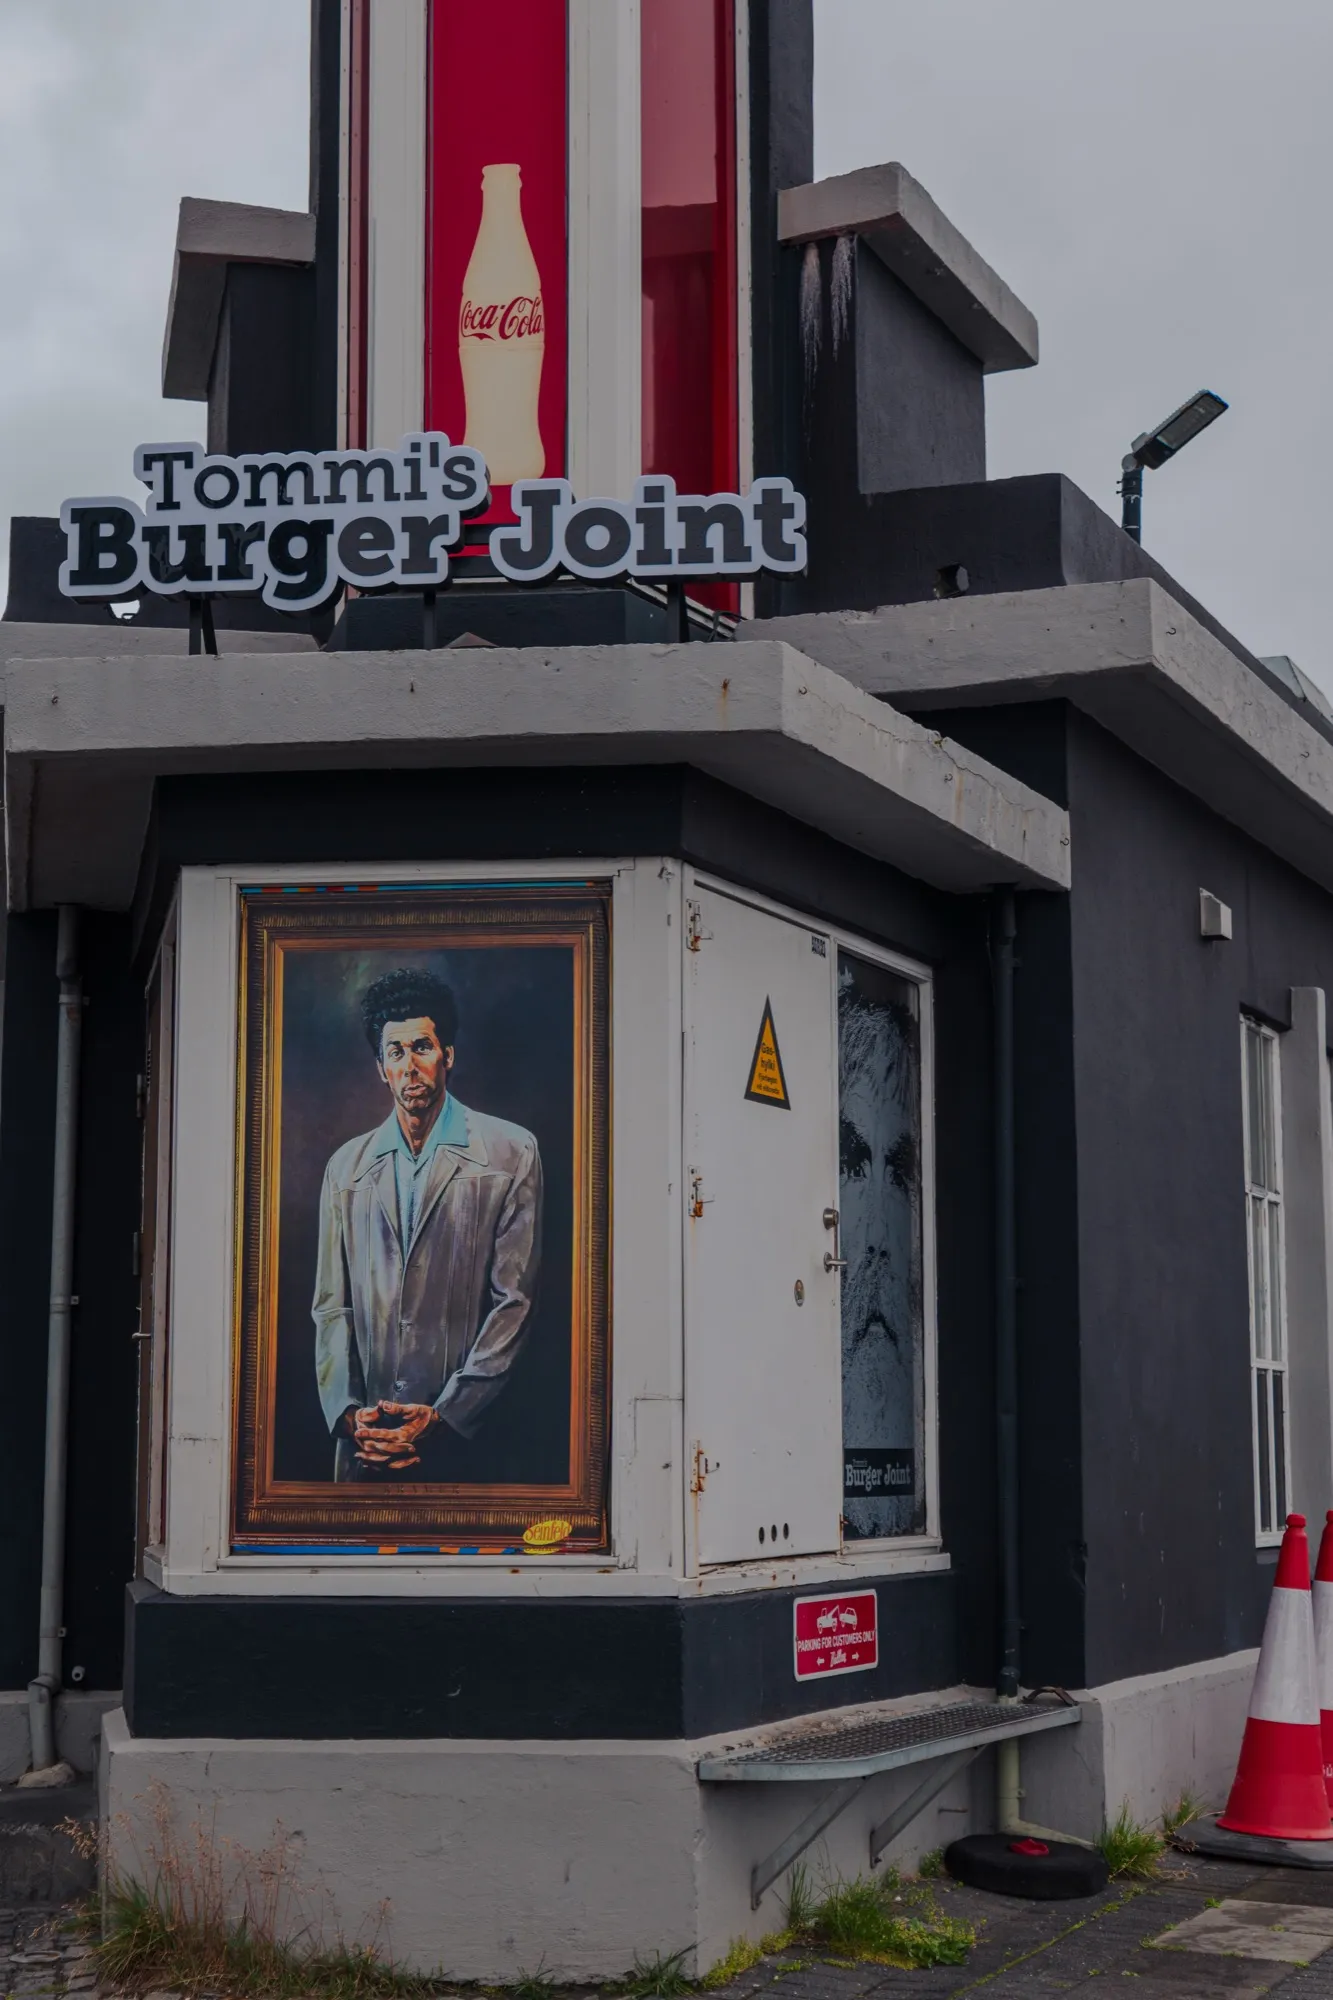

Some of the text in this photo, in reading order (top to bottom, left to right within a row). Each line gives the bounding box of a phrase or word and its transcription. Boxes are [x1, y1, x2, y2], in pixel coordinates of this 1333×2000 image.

[461, 296, 543, 341] Coca-Cola
[142, 441, 477, 511] Tommi's
[69, 485, 796, 601] Burger Joint
[845, 1461, 911, 1492] Burger Joint
[524, 1519, 572, 1541] Seinfeld
[797, 1630, 875, 1653] PARKING FOR CUSTOMERS ONLY
